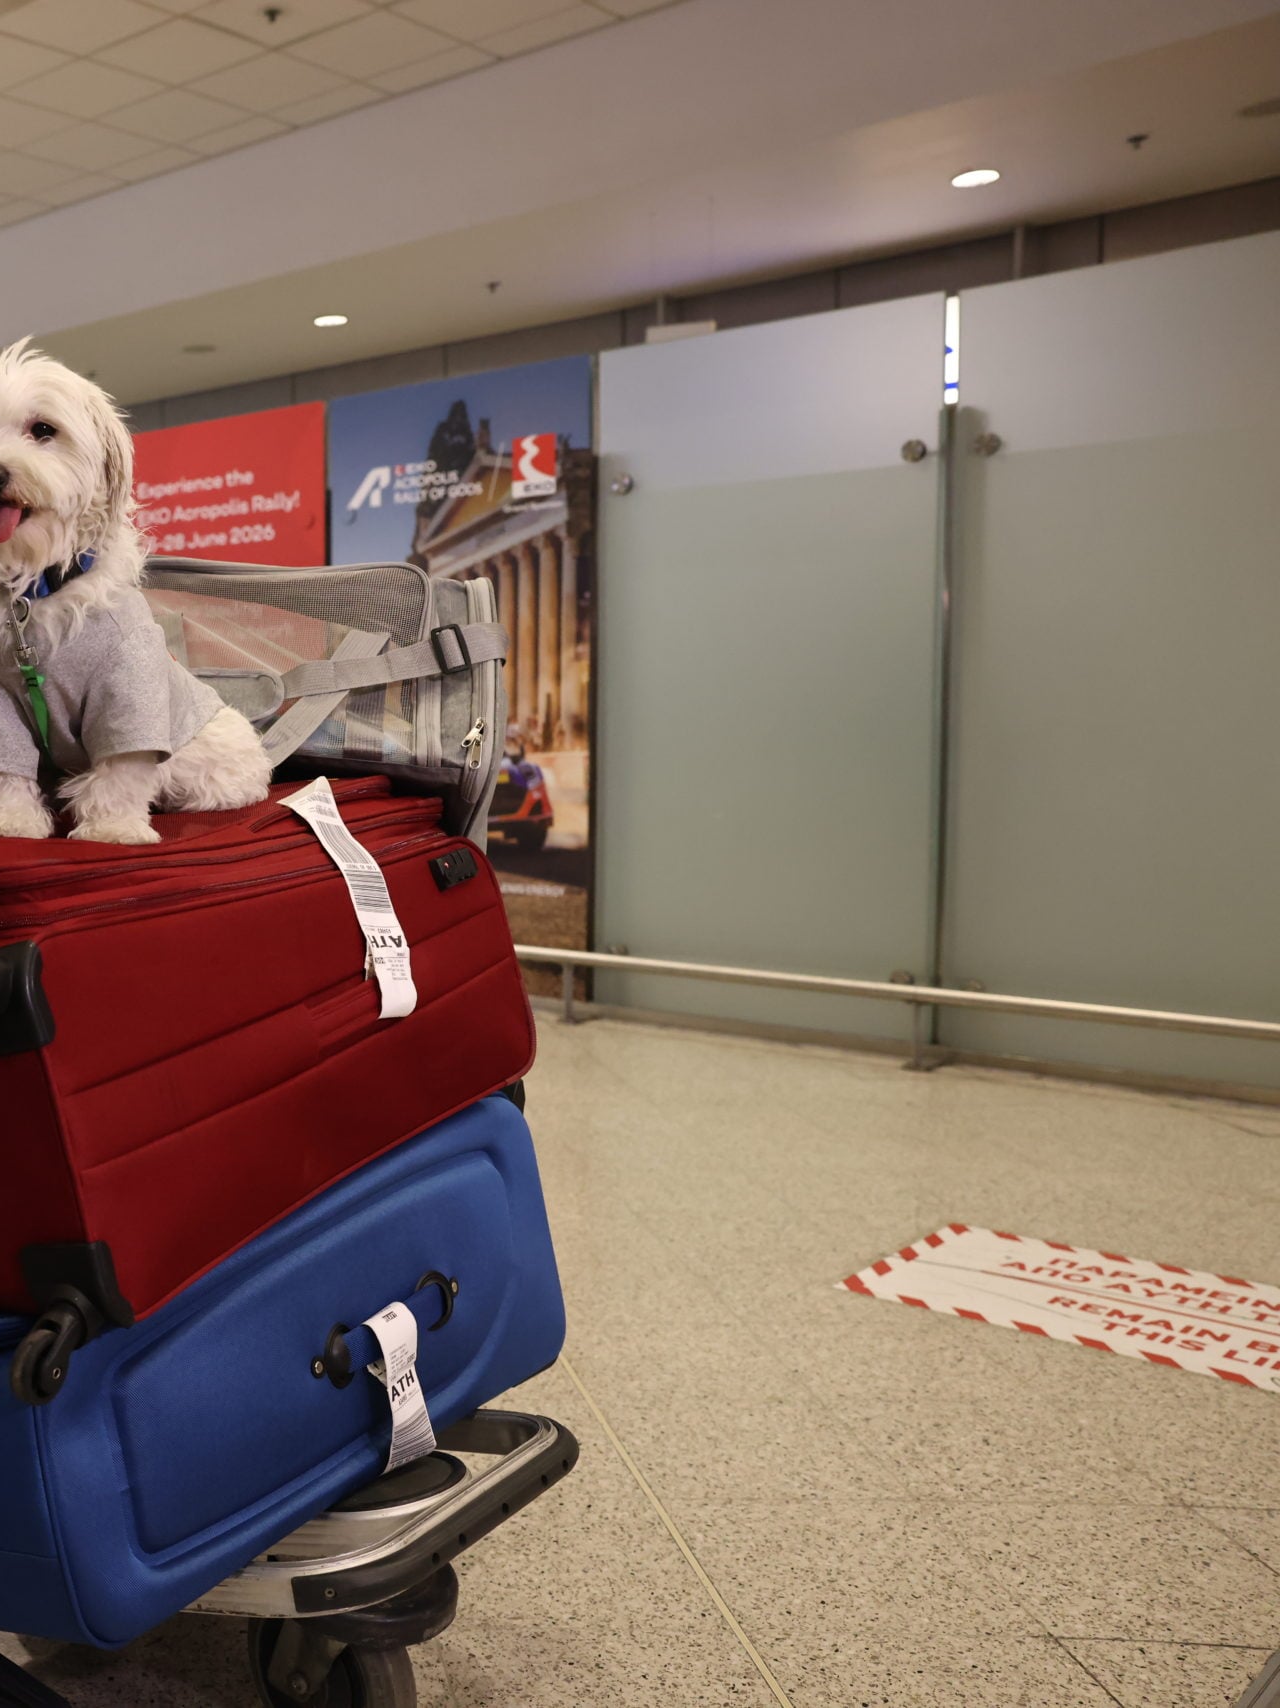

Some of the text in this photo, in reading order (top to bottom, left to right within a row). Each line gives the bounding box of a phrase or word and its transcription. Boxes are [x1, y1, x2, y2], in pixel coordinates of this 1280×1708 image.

[137, 468, 254, 500] Experience the
[394, 470, 459, 490] ACROPOLIS
[394, 481, 484, 505] RALLY OF GODS
[523, 479, 556, 492] EKO
[172, 497, 249, 522] Acropolis
[251, 490, 301, 514] Rally!
[187, 530, 228, 550] June
[229, 523, 276, 545] 2026
[367, 934, 402, 948] ATH
[999, 1261, 1092, 1284] ΑΠΟ
[1250, 1309, 1280, 1326] Τ
[1046, 1296, 1231, 1343] REMAIN
[1101, 1319, 1280, 1372] THIS LI
[391, 1369, 415, 1402] ATH
